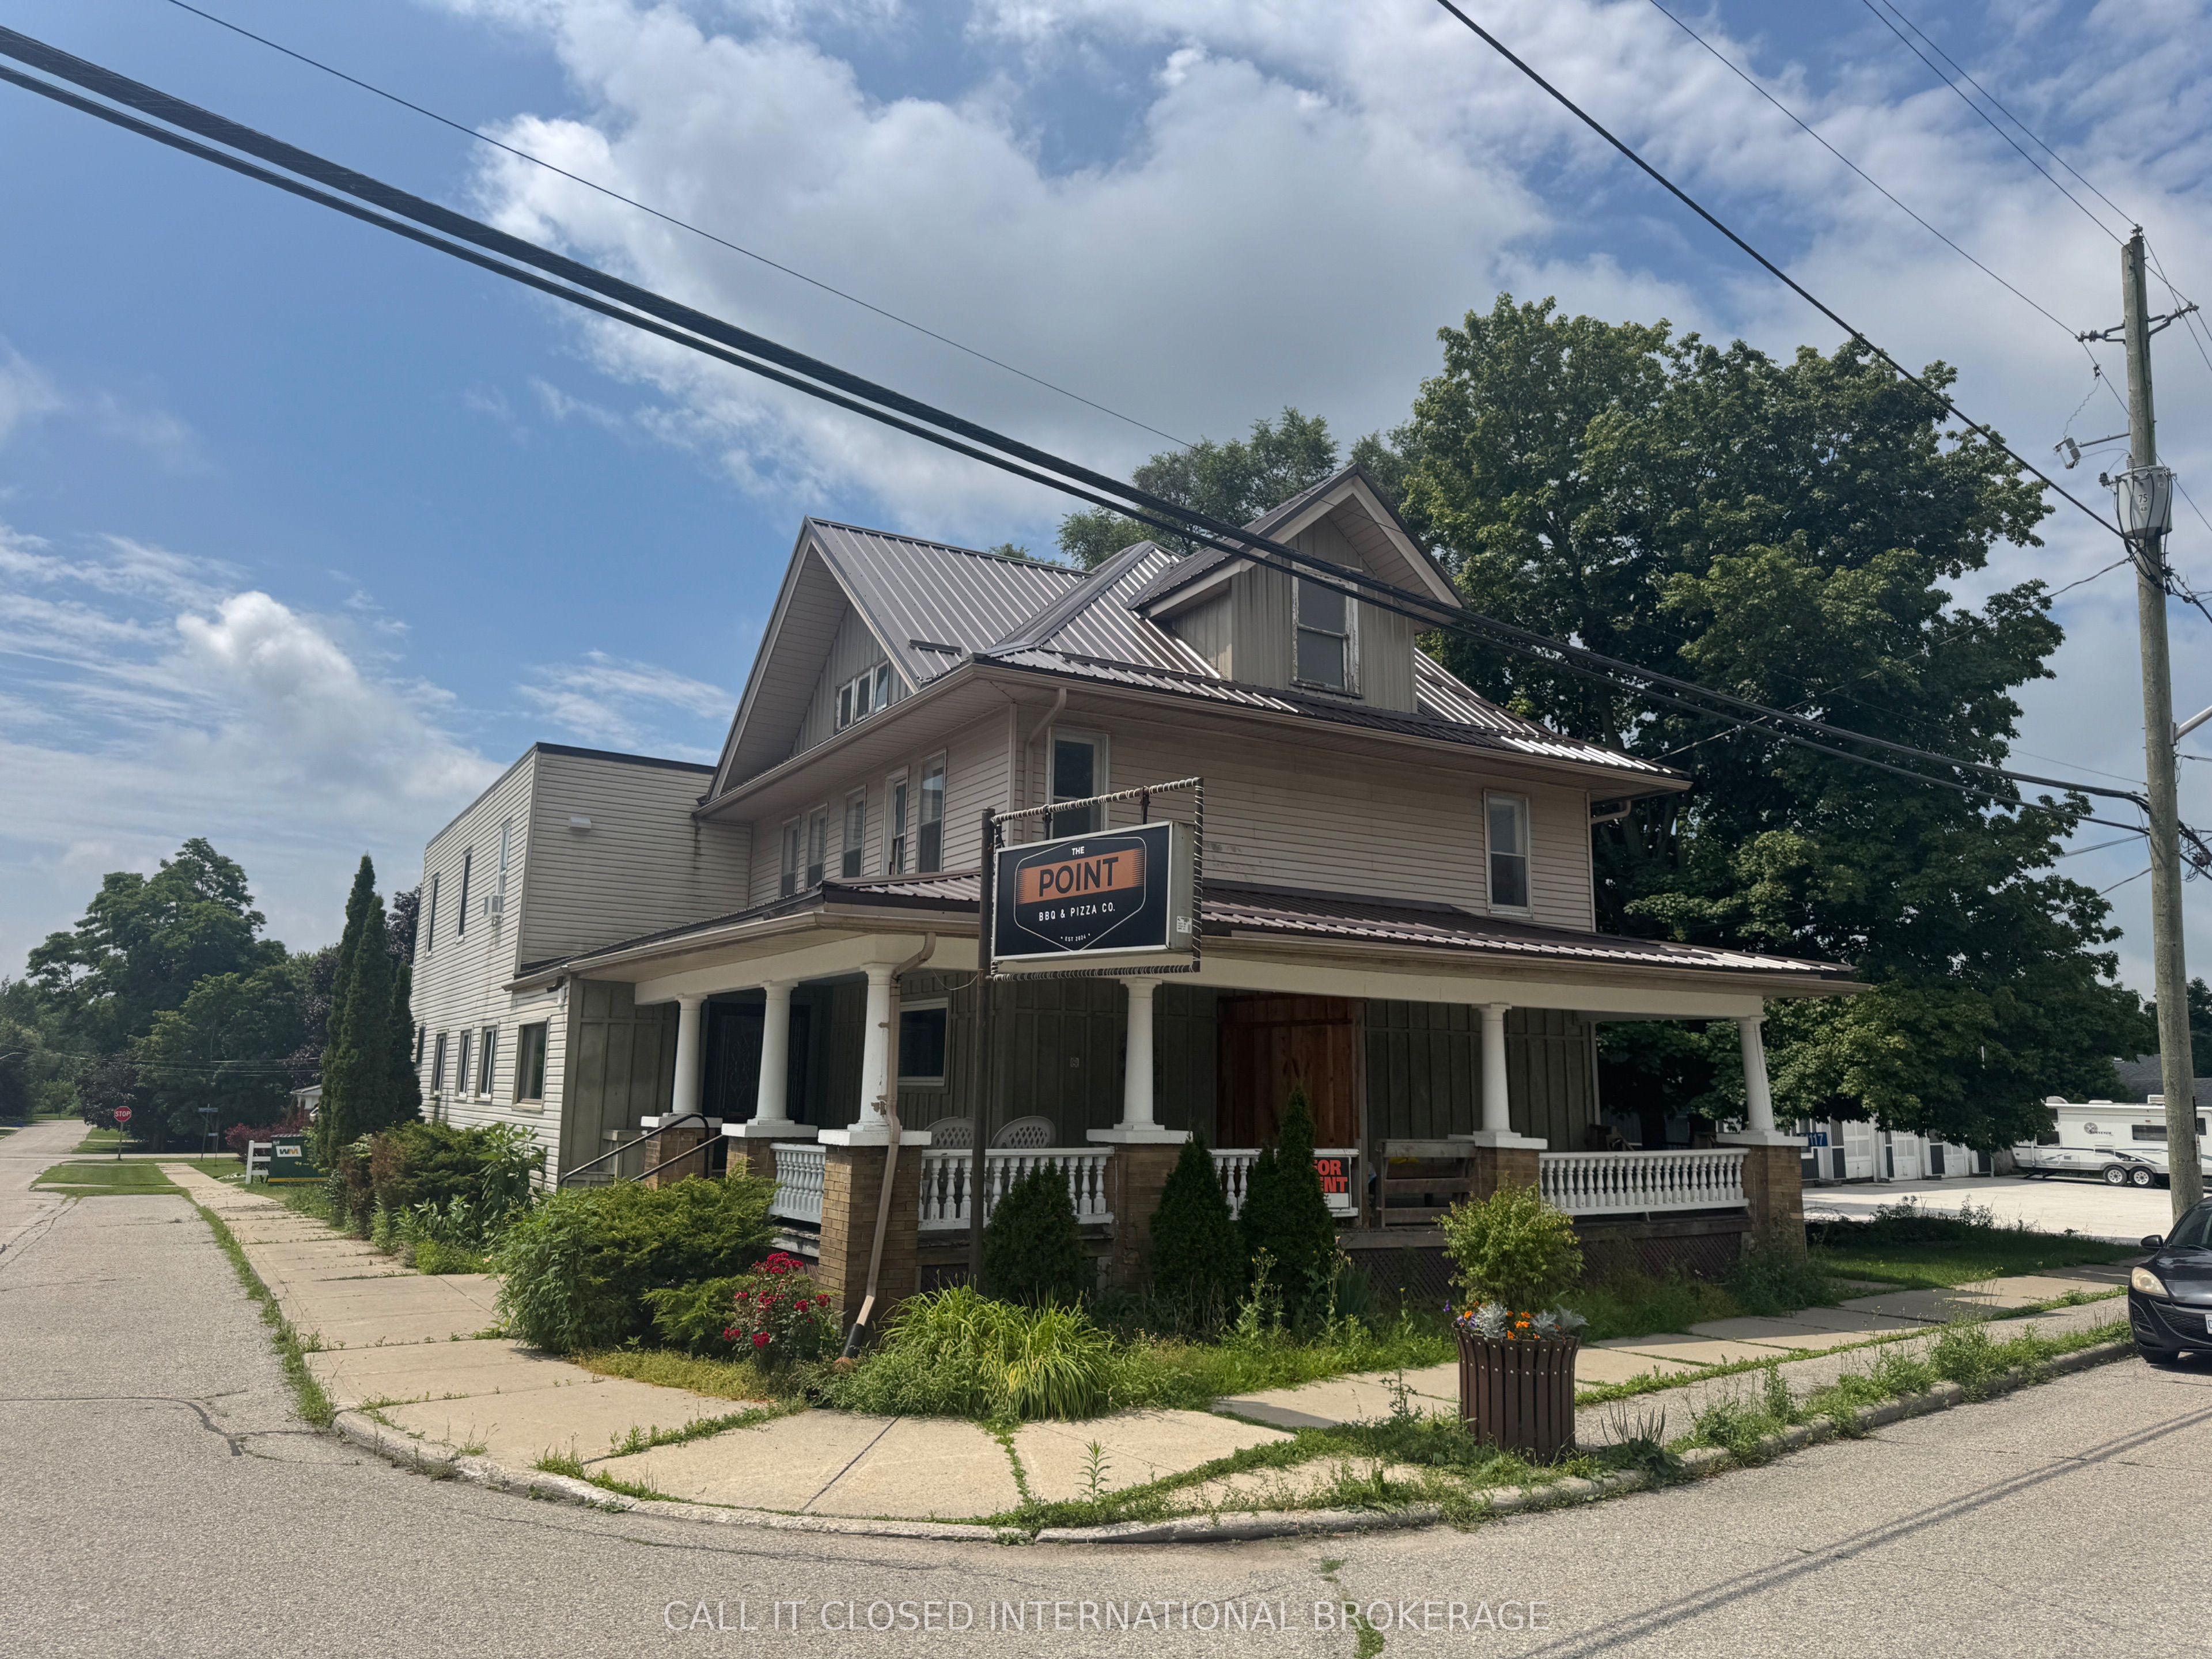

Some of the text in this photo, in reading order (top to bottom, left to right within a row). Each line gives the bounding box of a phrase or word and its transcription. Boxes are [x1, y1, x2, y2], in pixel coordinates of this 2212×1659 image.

[2138, 494, 2147, 503] 75
[1071, 846, 1085, 855] THE
[1039, 857, 1119, 897] POINT
[1039, 902, 1115, 922] BBQ & PIZZA CO.
